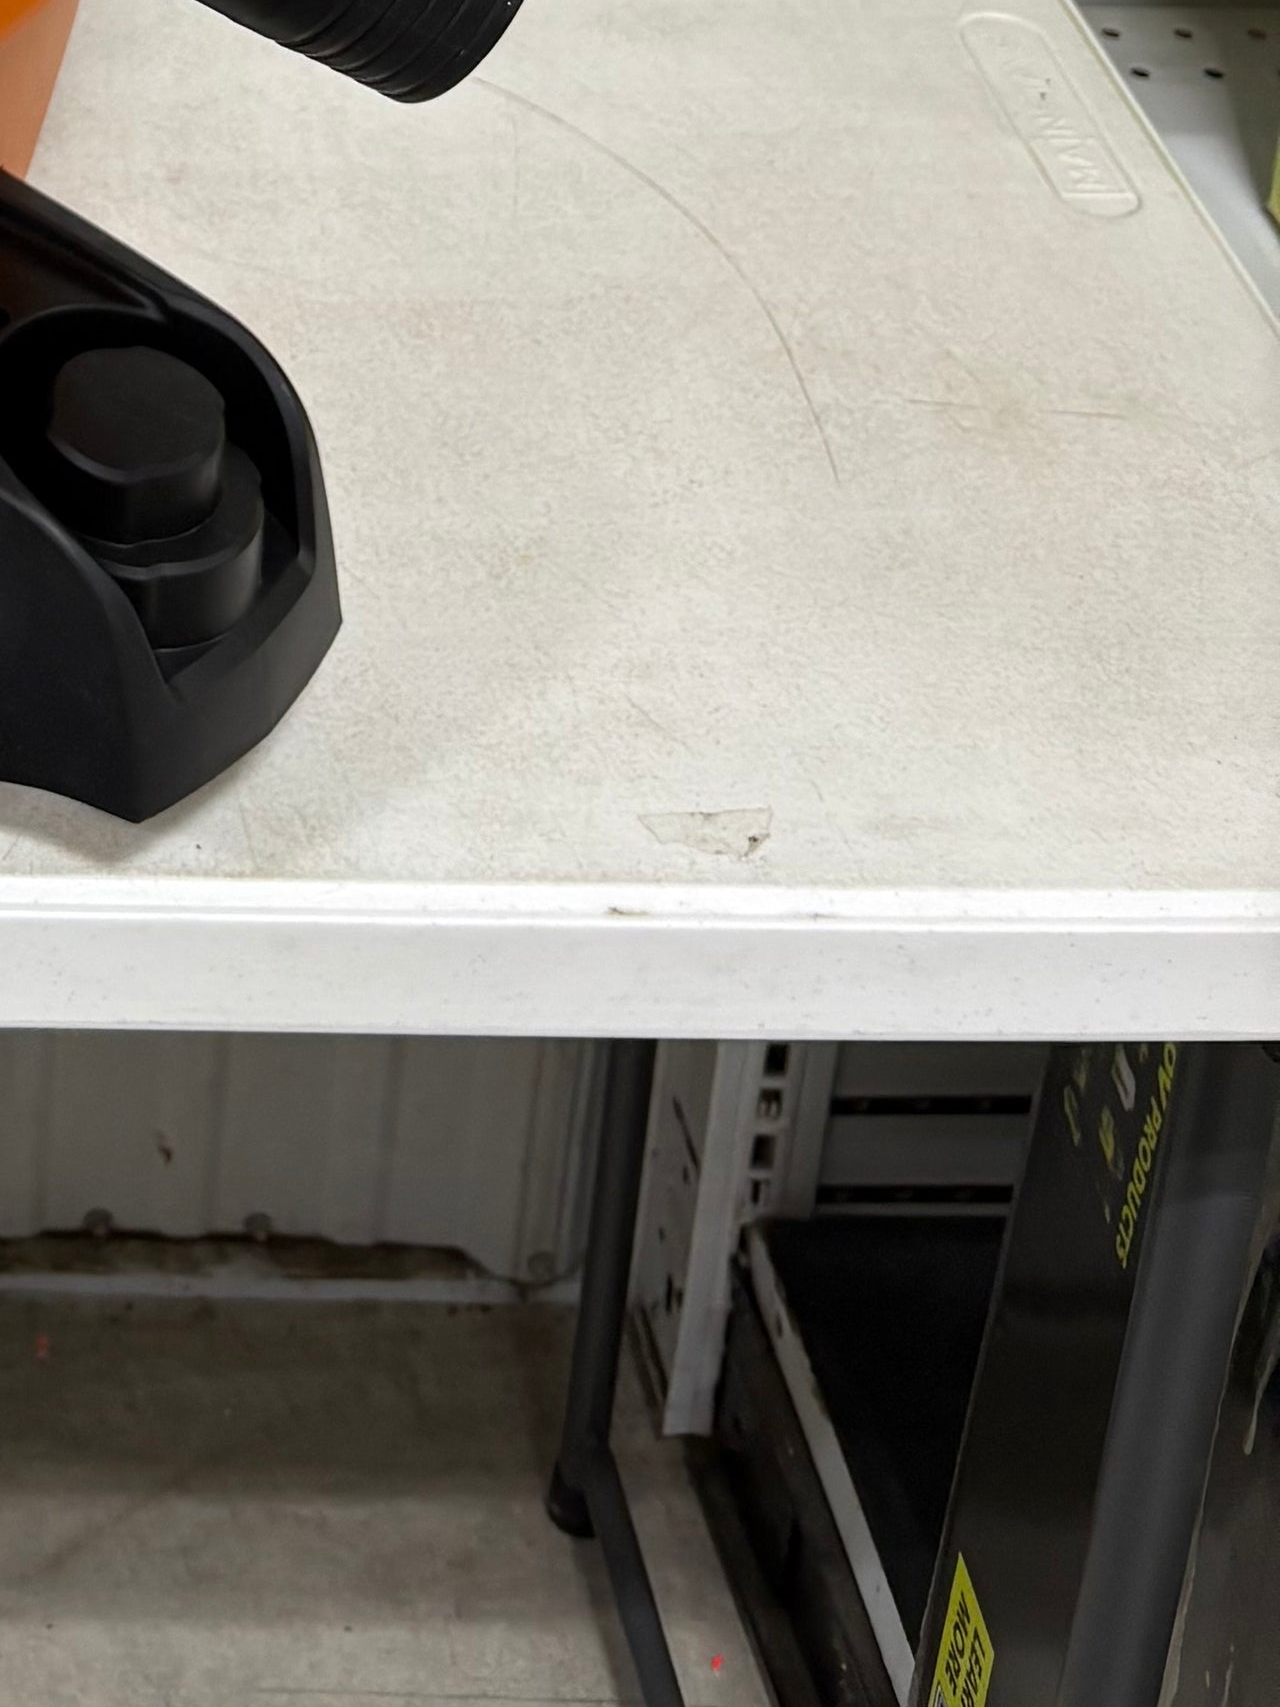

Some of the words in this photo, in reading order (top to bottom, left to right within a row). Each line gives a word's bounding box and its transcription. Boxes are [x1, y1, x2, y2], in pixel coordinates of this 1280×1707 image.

[1115, 1096, 1163, 1271] PRODUCTS
[944, 1590, 971, 1697] MORE
[960, 1625, 986, 1707] LEAR
